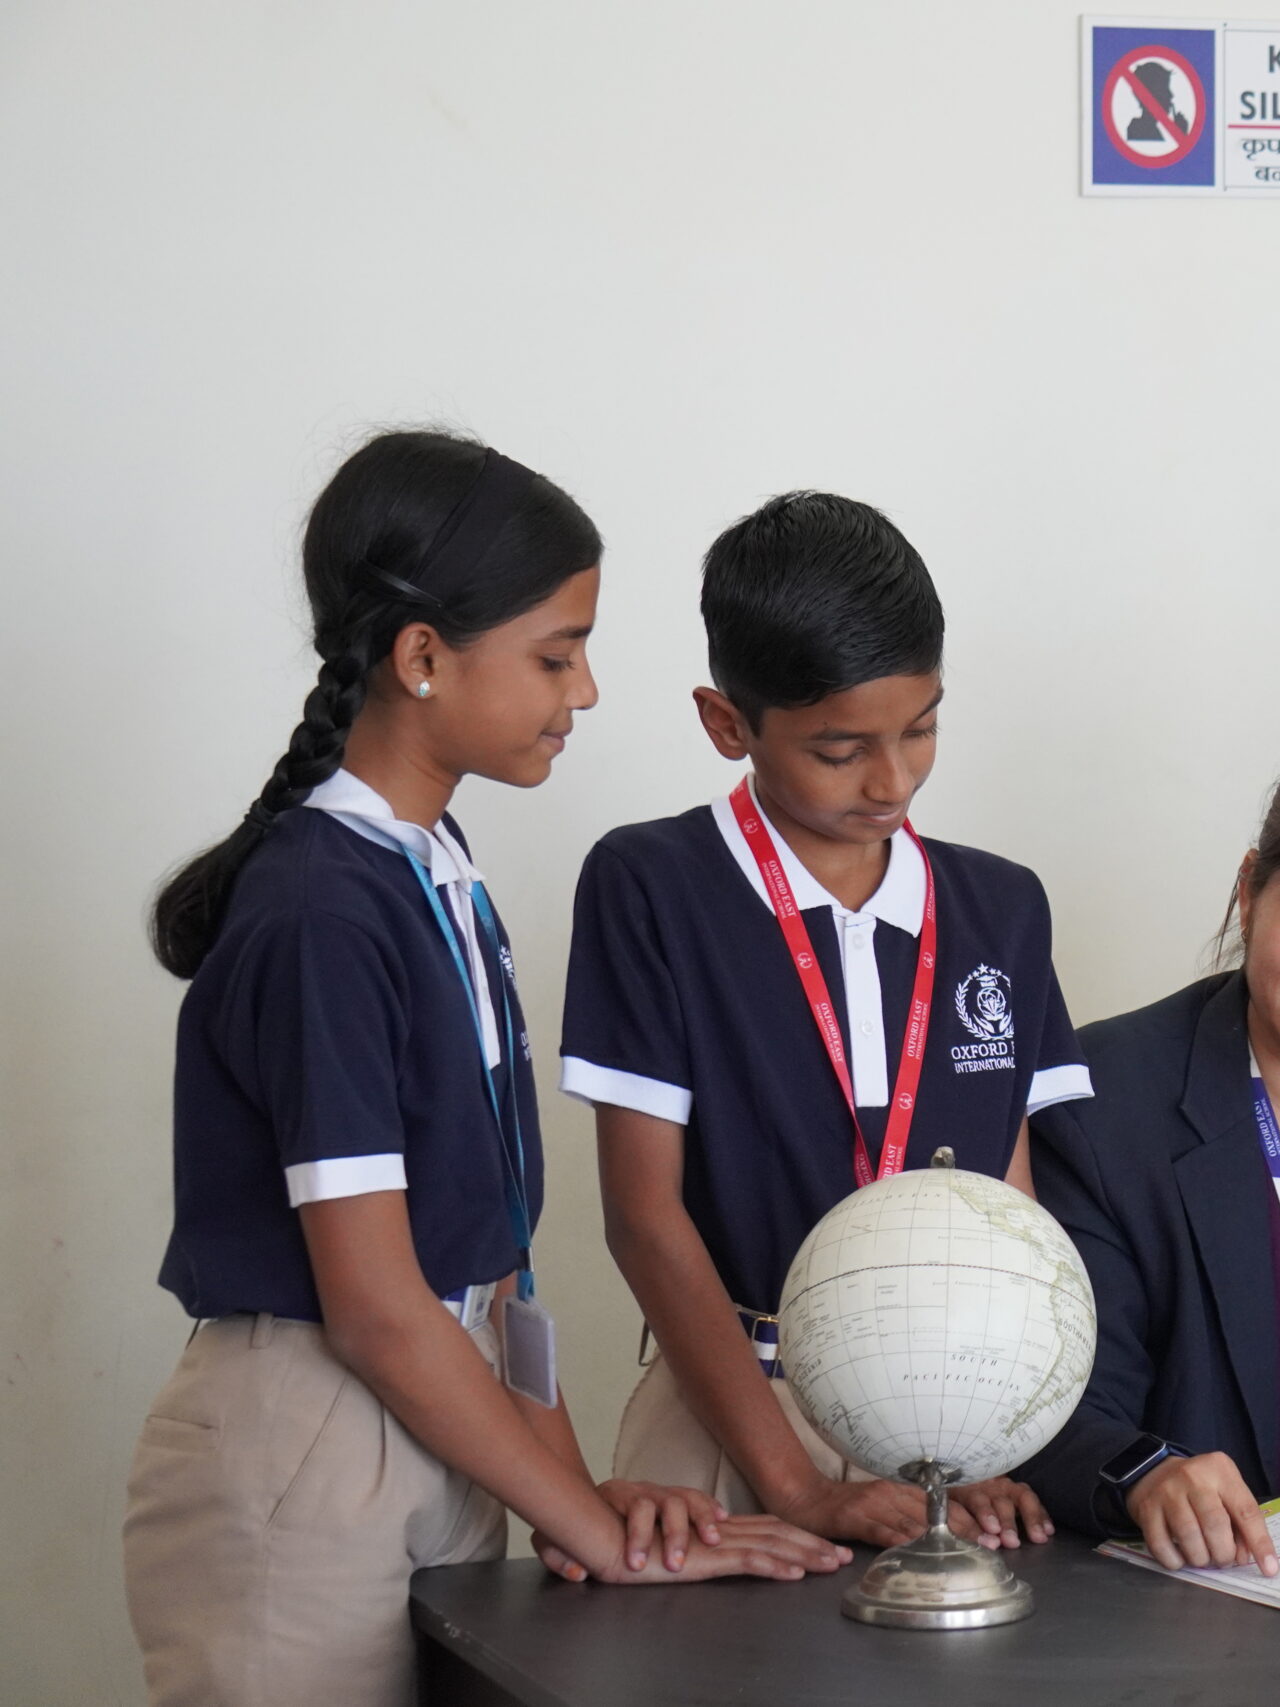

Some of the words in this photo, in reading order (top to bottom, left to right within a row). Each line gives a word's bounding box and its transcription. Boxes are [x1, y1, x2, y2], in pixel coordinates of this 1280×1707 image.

[768, 860, 788, 895] OXFORD
[782, 895, 797, 917] EAST
[913, 998, 923, 1021] EAST
[821, 1002, 839, 1039] OXFORD
[833, 1040, 843, 1062] EAST
[907, 1021, 920, 1057] OXFORD
[951, 1041, 1008, 1060] OXFORD
[954, 1056, 1016, 1074] INTERNATIONAL
[1254, 1101, 1266, 1122] EAST
[1259, 1122, 1277, 1157] OXFORD
[885, 1144, 897, 1166] EAST
[951, 1353, 998, 1366] SOUTH
[903, 1373, 971, 1382] PACIFIC
[978, 1377, 1020, 1391] OCEAN
